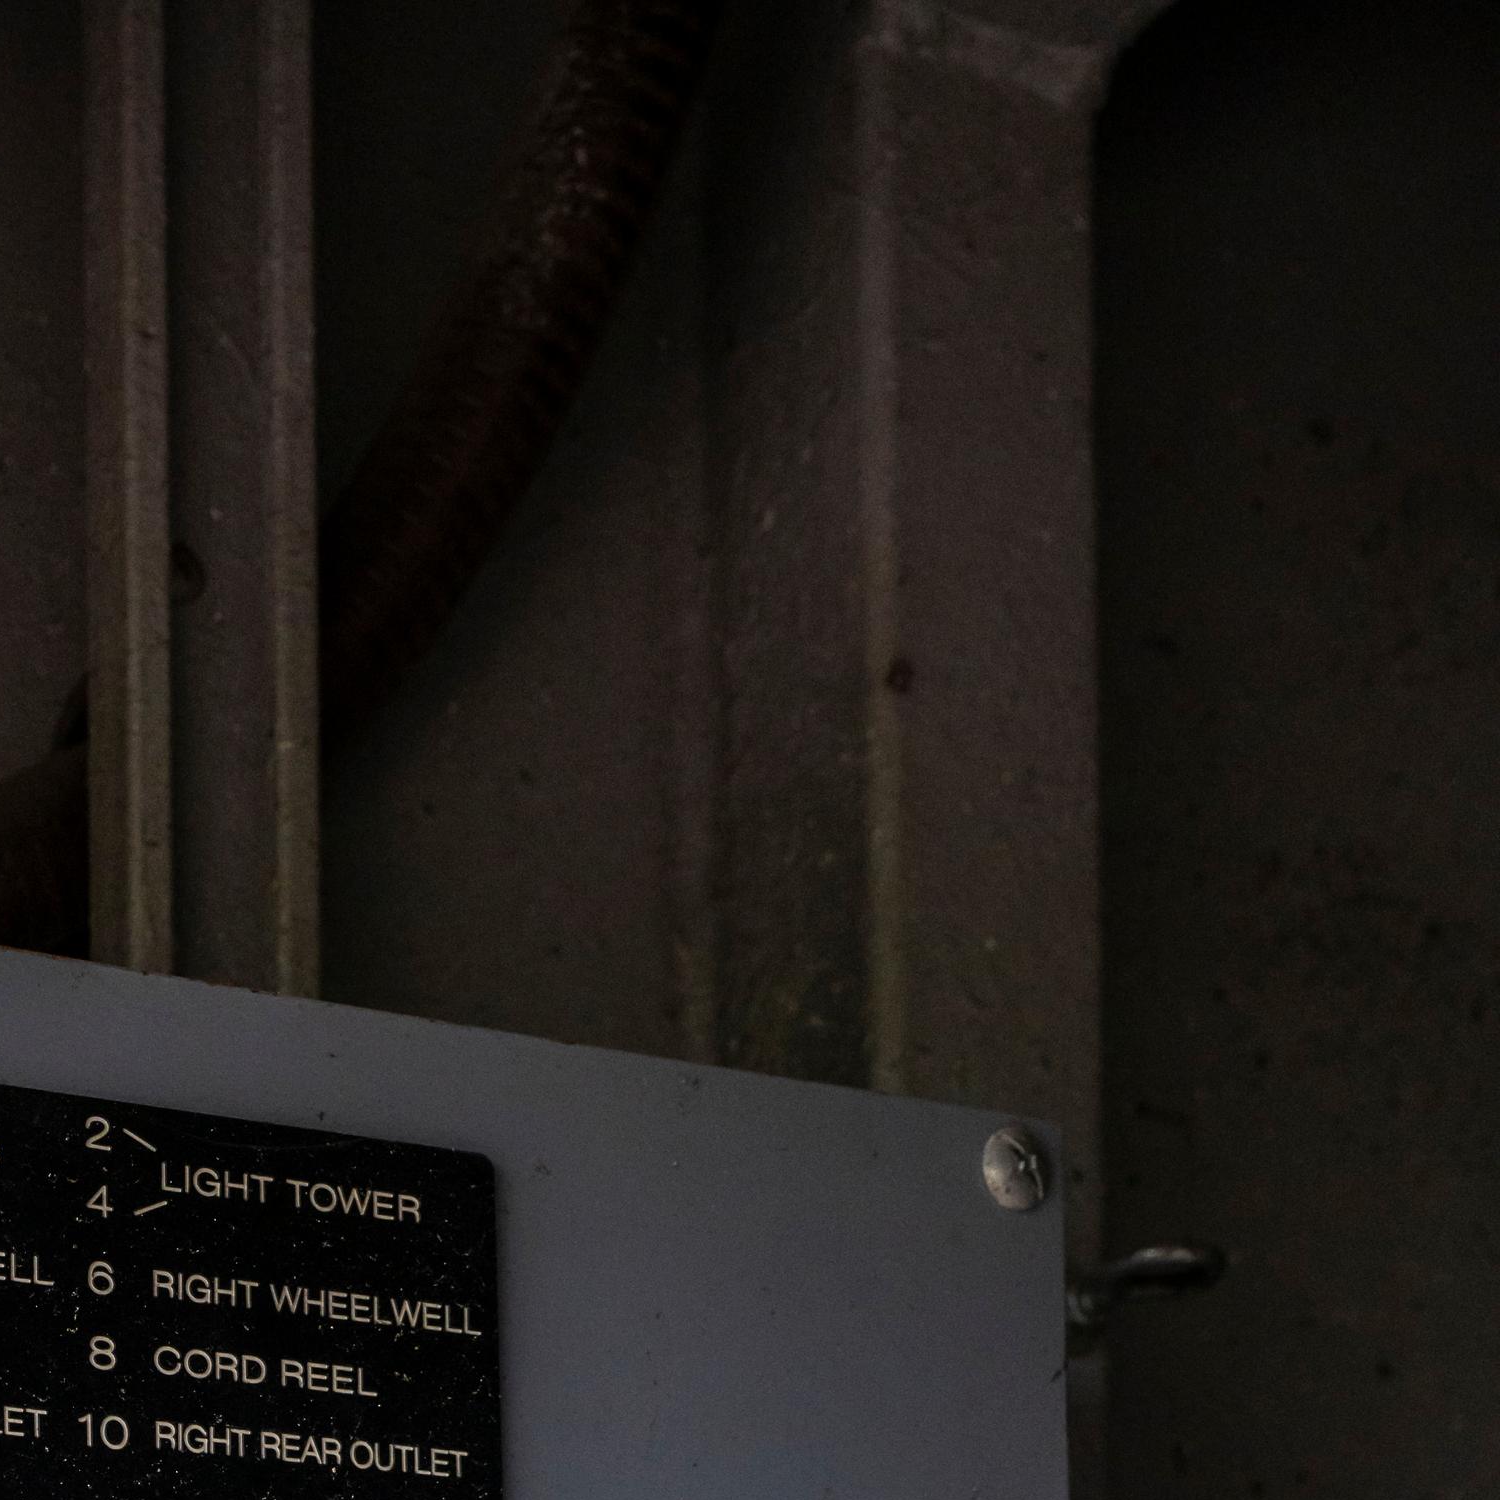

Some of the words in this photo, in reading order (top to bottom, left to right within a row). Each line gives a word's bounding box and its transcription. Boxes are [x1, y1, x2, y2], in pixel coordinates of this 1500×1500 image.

[85, 1116, 112, 1152] 2
[87, 1185, 113, 1218] 4
[161, 1162, 274, 1203] LIGHT
[286, 1179, 420, 1223] TOWER
[88, 1261, 115, 1295] 6
[153, 1269, 259, 1308] RIGHT
[270, 1284, 482, 1336] WHEELWELL
[89, 1335, 117, 1371] 8
[153, 1345, 266, 1384] CORD
[281, 1359, 378, 1397] REEL
[78, 1413, 129, 1450] 10
[155, 1420, 252, 1457] RIGHT
[260, 1431, 342, 1465] REAR
[349, 1440, 469, 1477] OUTLET
